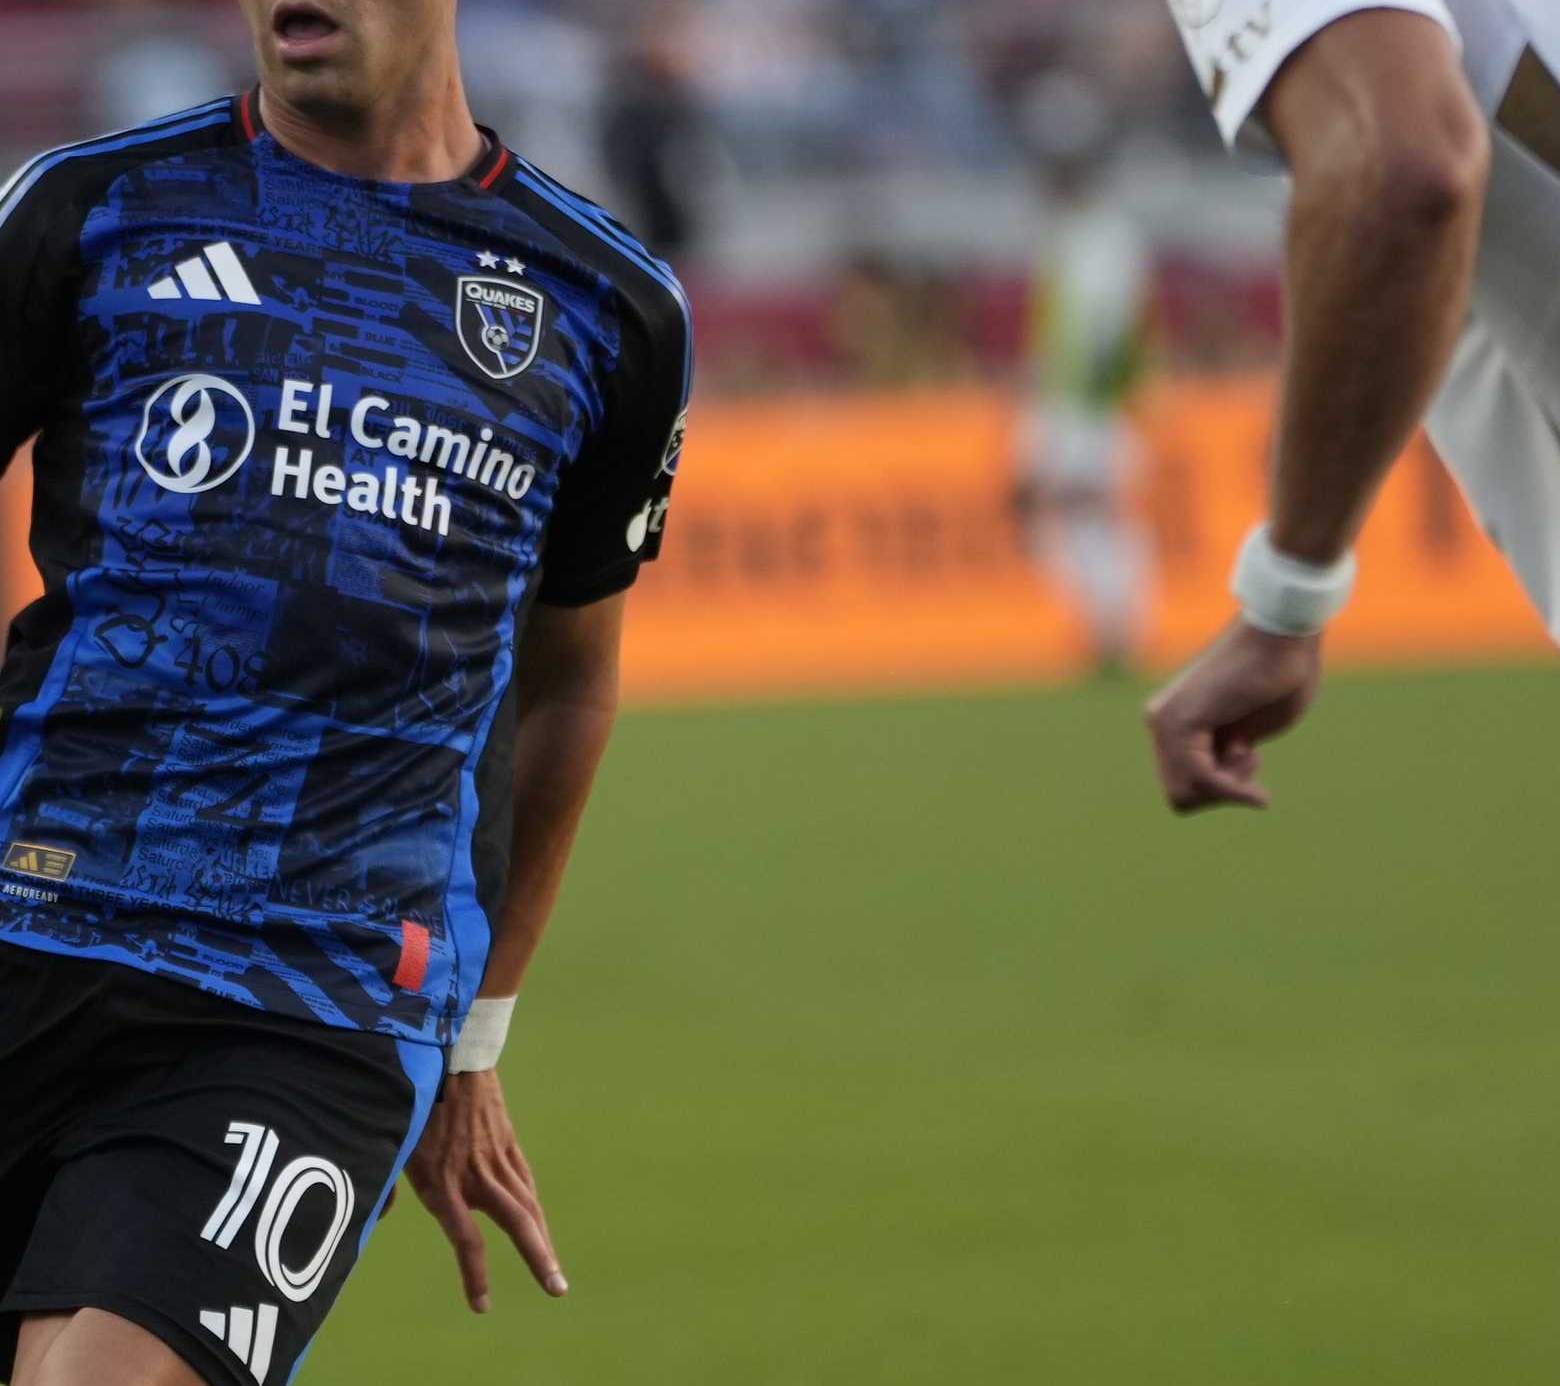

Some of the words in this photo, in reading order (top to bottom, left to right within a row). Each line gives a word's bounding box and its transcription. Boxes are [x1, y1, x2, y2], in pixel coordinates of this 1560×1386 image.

[354, 296, 399, 313] BLOOD
[464, 282, 536, 315] QUAKES
[364, 331, 396, 347] BLUE
[277, 378, 333, 439] El
[349, 394, 537, 501] Camino
[270, 445, 453, 537] Health
[2, 883, 60, 905] AEROREADY
[76, 885, 126, 905] THREE
[202, 953, 247, 971] BLOOD
[198, 1120, 357, 1304] 10
